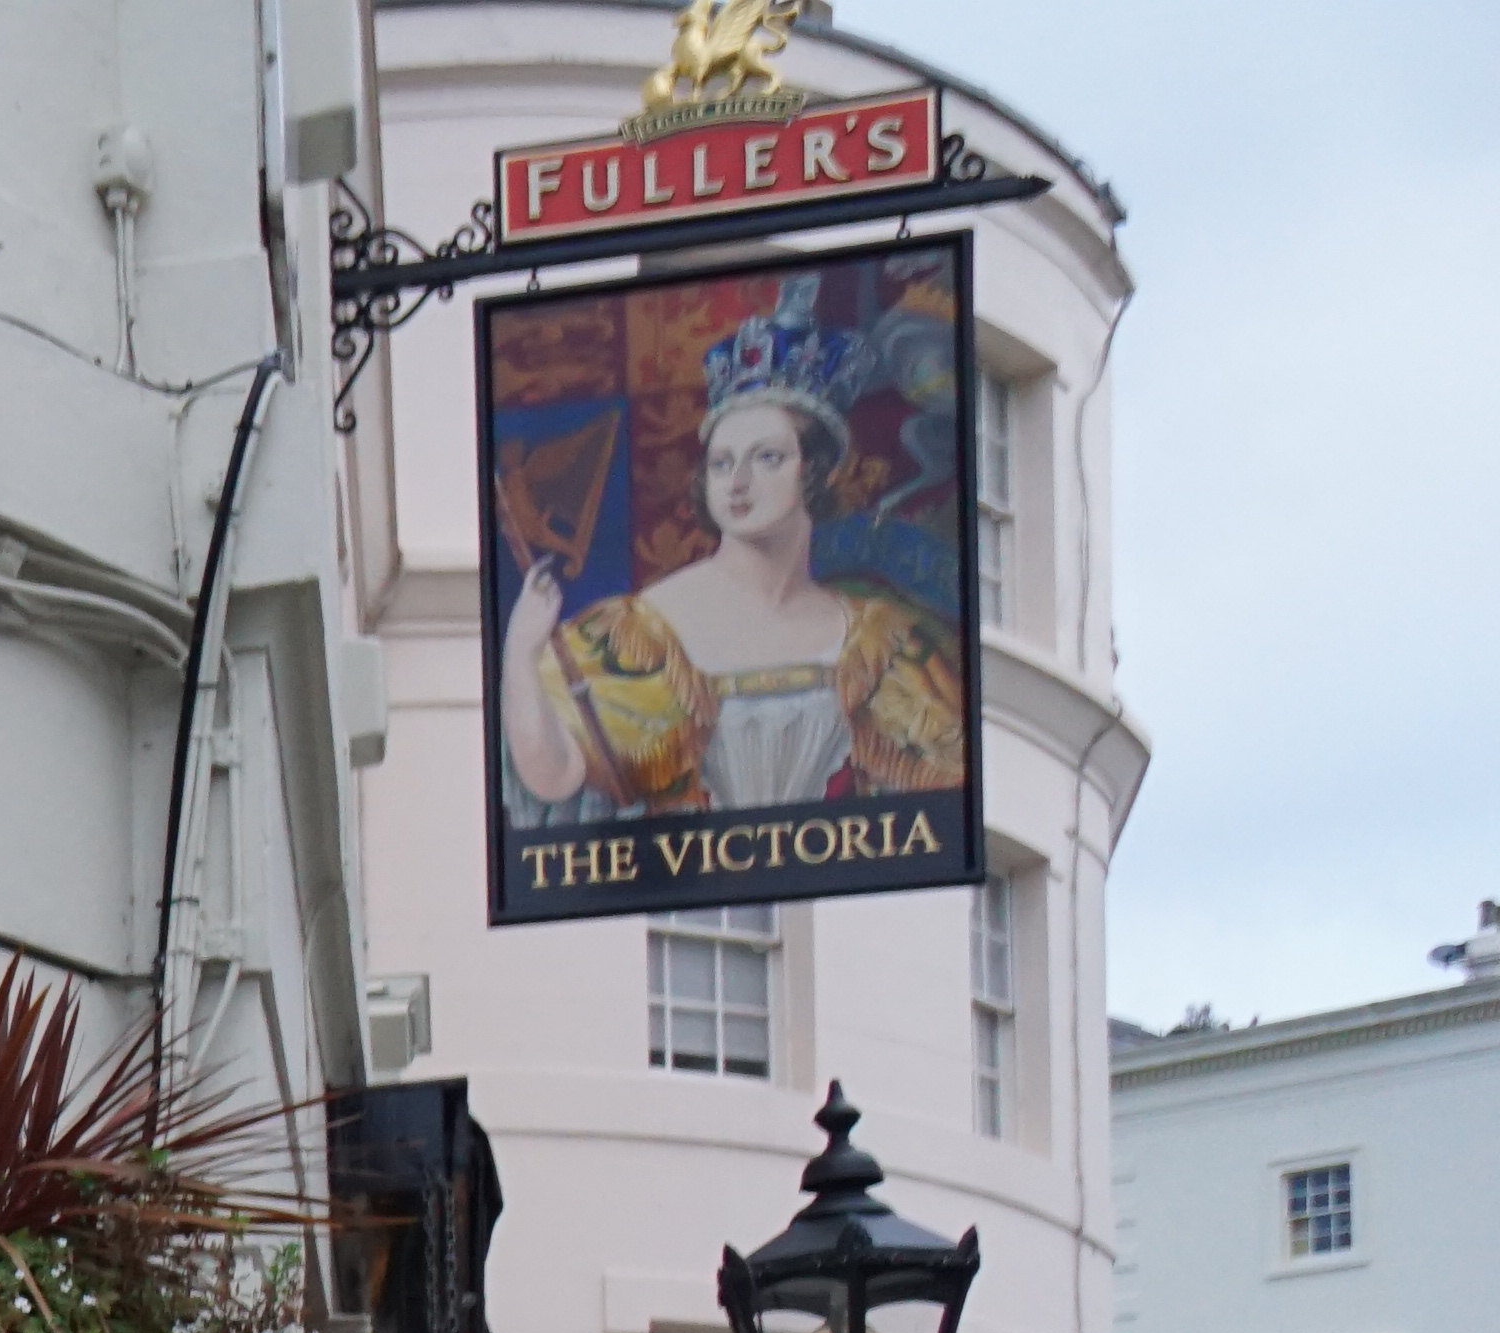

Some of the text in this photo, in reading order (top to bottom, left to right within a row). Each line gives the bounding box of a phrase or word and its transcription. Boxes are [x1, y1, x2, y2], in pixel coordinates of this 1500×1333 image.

[526, 115, 907, 221] FULLER'S
[521, 811, 941, 890] THE VICTORIA
